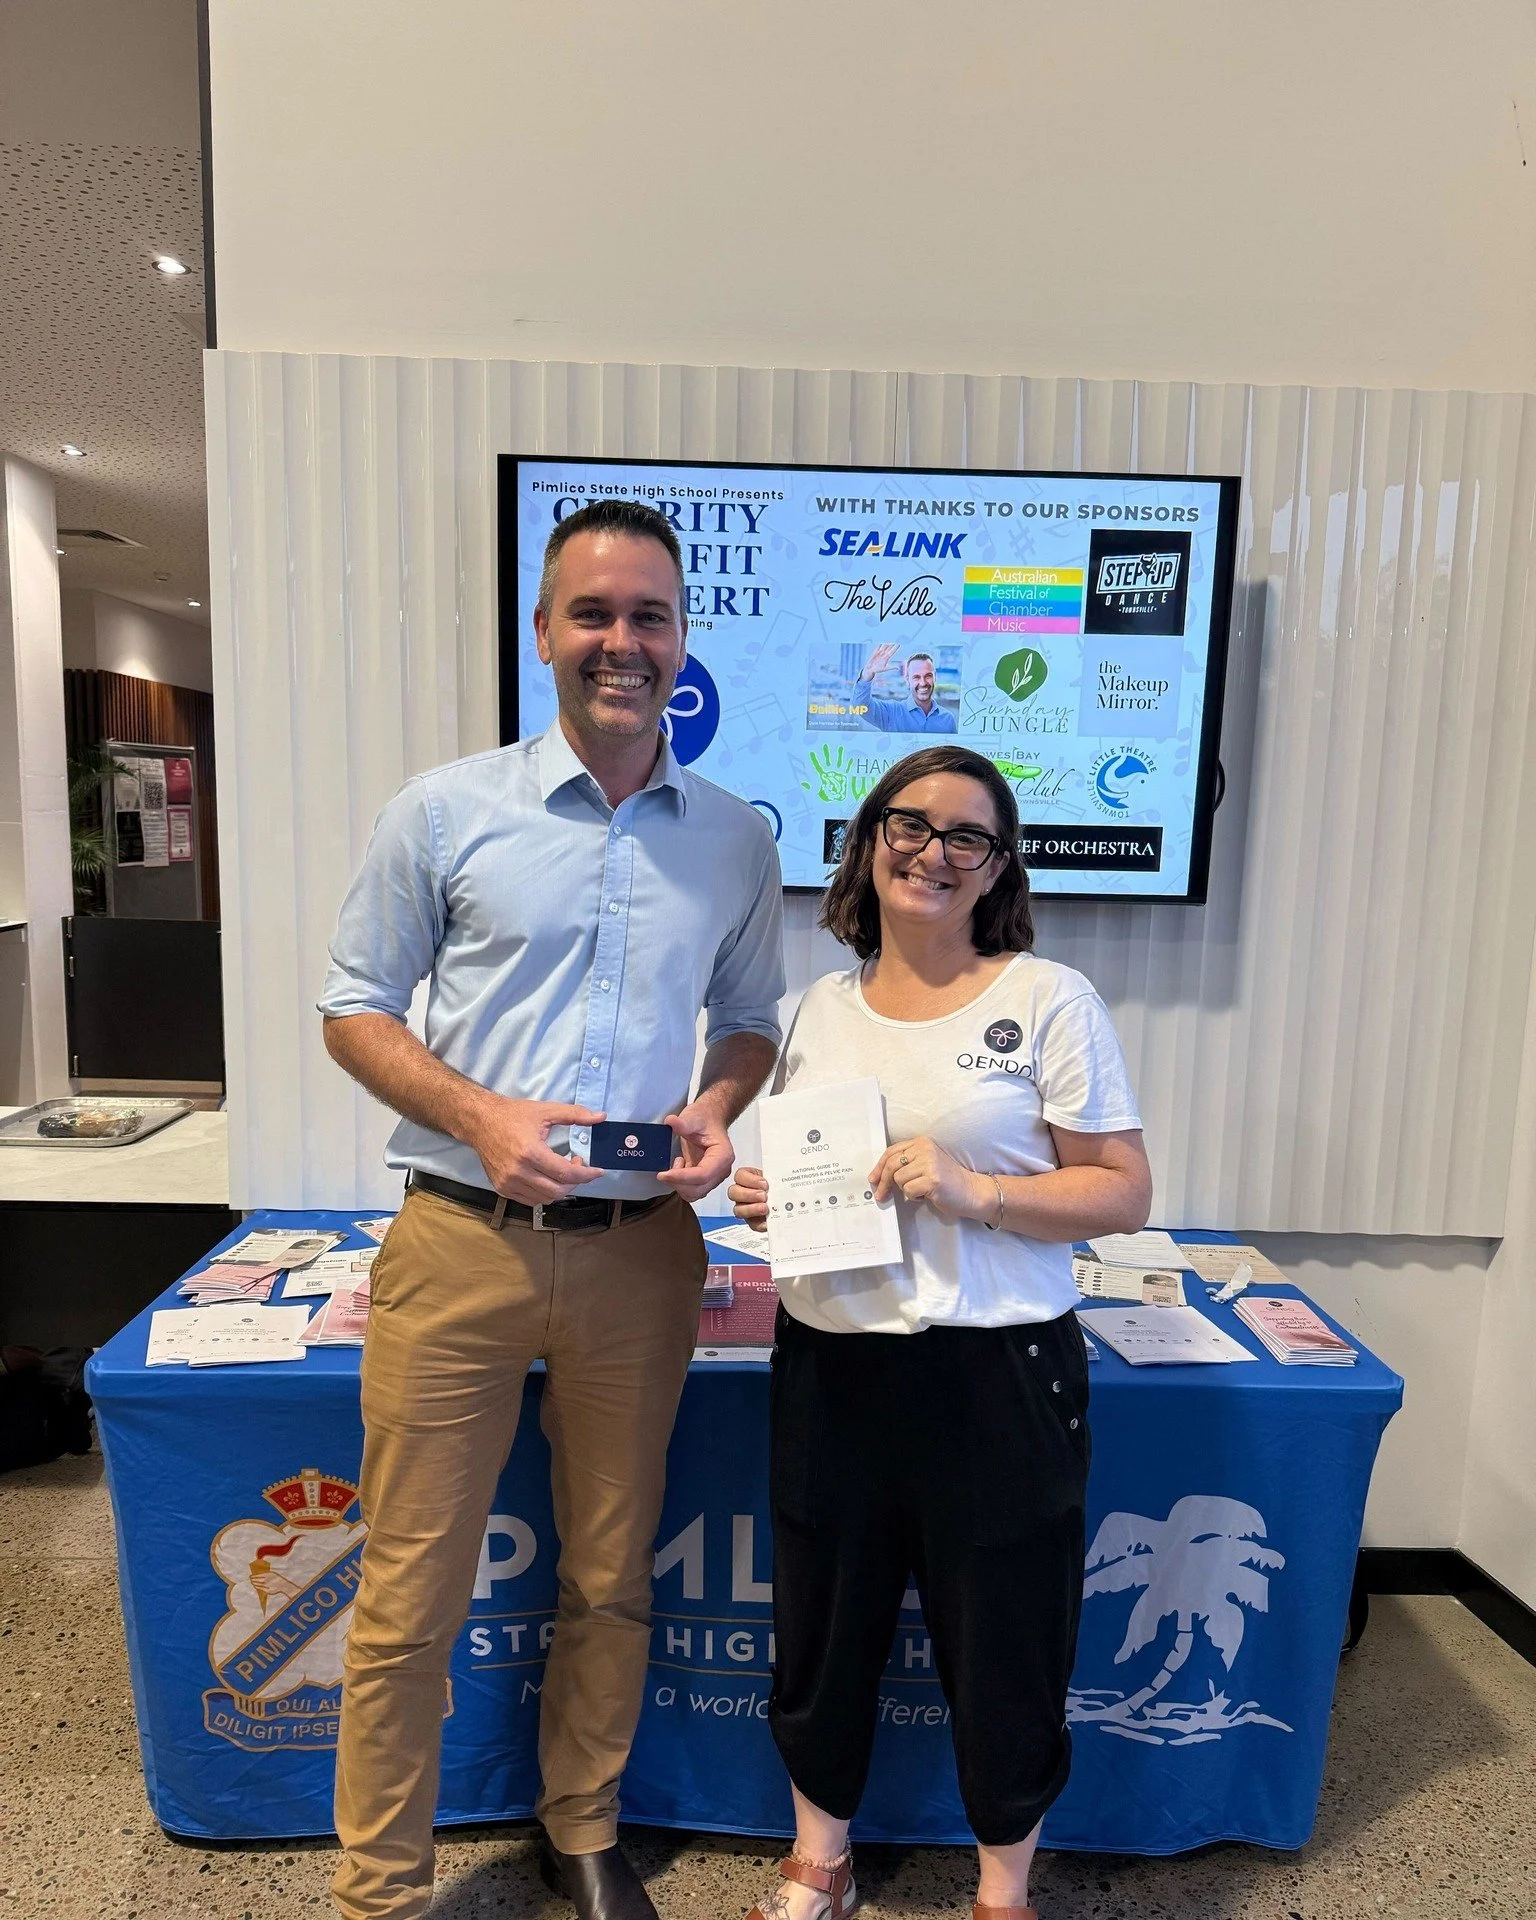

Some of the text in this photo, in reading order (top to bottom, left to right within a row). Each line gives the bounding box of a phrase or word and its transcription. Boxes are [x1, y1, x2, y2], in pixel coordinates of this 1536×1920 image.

[532, 481, 785, 500] Pimlico State High School Presents
[552, 497, 769, 534] CRITY
[815, 497, 1200, 523] WITH THANKS TO OUR SPONSORS
[818, 527, 968, 559] SEALINK
[687, 543, 763, 575] FIT
[991, 568, 1058, 584] Australian
[1104, 561, 1143, 587] STEP
[686, 585, 770, 617] ERT
[824, 575, 943, 622] The Ville
[989, 584, 1051, 600] Festival of
[1104, 591, 1168, 606] DANCE
[988, 601, 1053, 616] Chamber
[987, 617, 1026, 632] Music
[1099, 660, 1122, 674] the
[1097, 675, 1169, 697] Makeup
[962, 686, 1075, 727] Sunday
[1096, 694, 1158, 711] Mirror.
[979, 717, 1069, 734] JUNGLE
[1016, 751, 1040, 760] BAY
[1089, 748, 1116, 776] LITTLE
[1119, 746, 1158, 773] THEATRE
[856, 758, 895, 774] HAN
[1015, 768, 1076, 797] Club
[1044, 840, 1155, 856] ORCHESTRA
[956, 1053, 1032, 1078] QENDO
[616, 1149, 645, 1157] QENDO
[800, 1143, 830, 1155] QENDO
[235, 1558, 363, 1683] PIMLICO HI
[655, 1686, 675, 1706] a
[213, 1712, 287, 1740] DILIGIT
